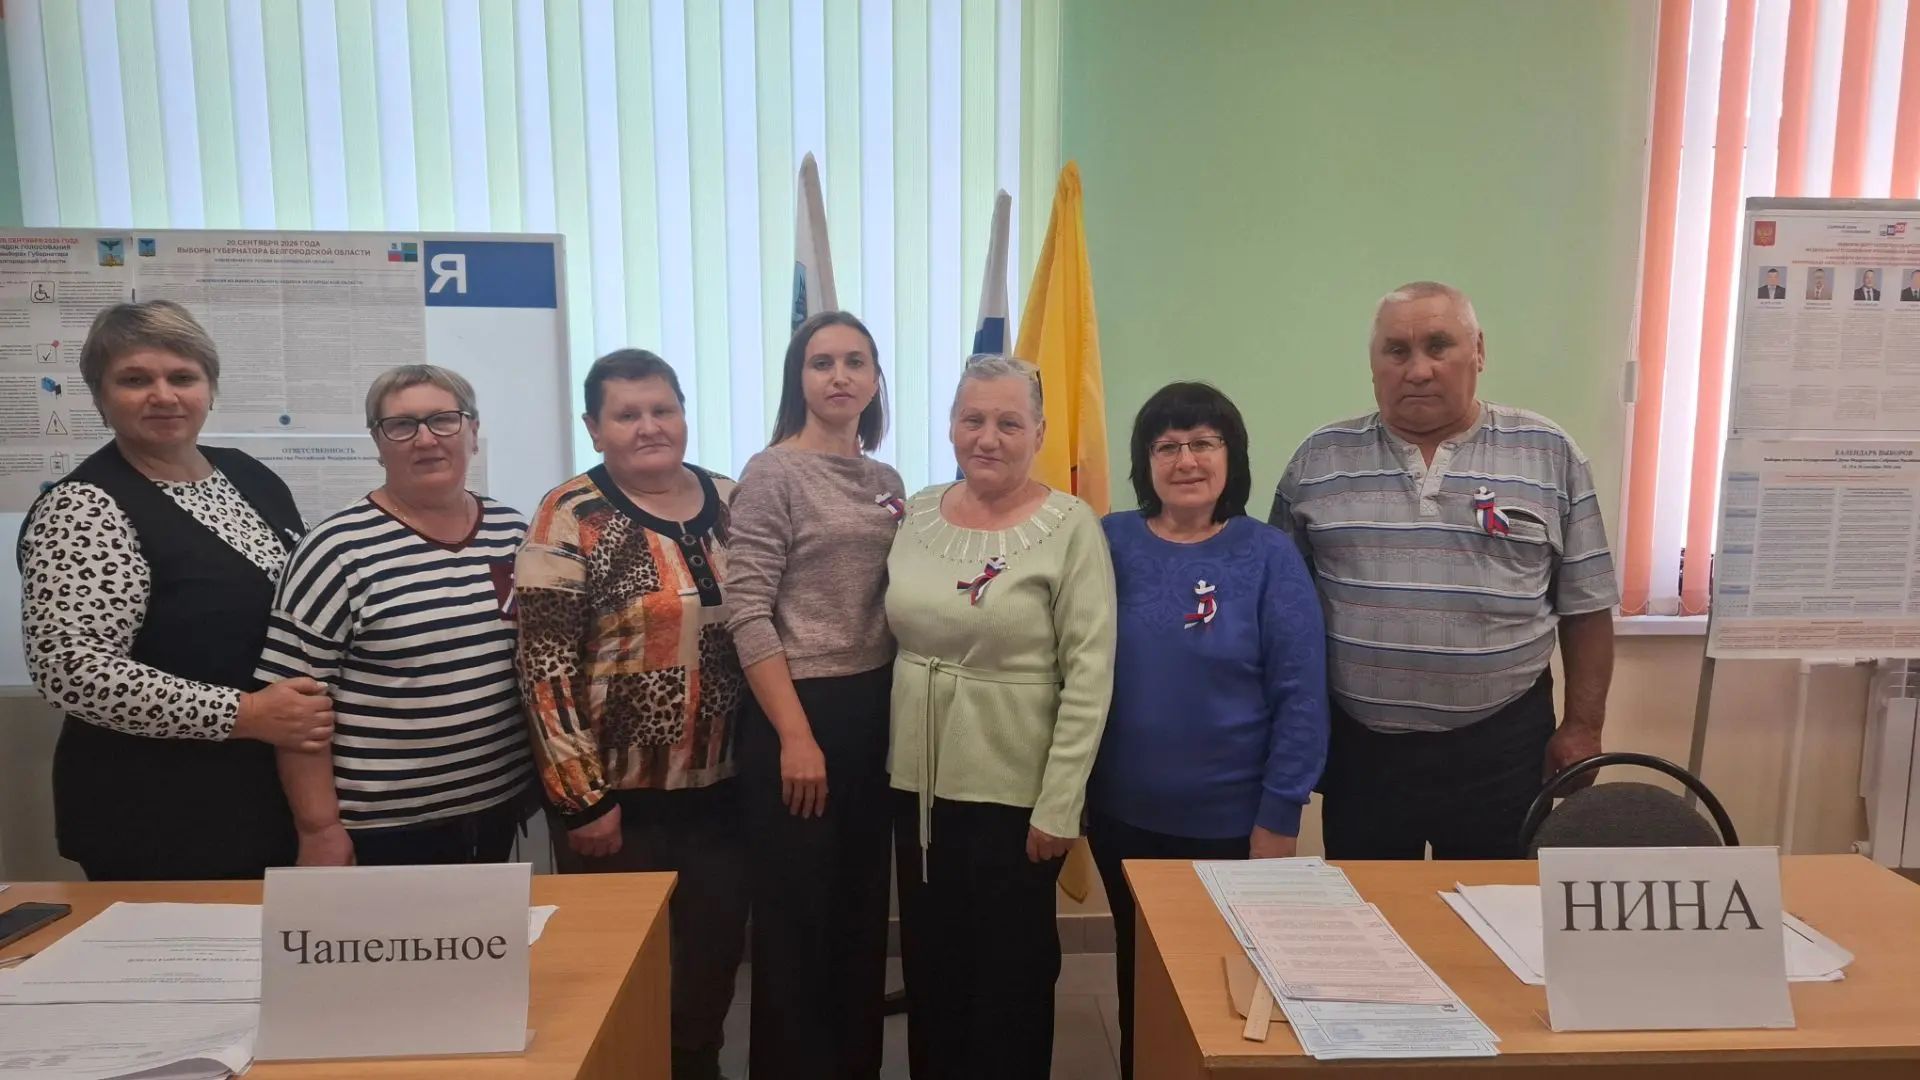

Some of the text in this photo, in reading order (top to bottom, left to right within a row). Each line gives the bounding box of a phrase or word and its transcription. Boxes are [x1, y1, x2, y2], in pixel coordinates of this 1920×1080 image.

[176, 246, 371, 256] ВЫБОРЫ ГУБЕРНАТОРА БЕЛГОРОДСКОЙ ОБЛАСТИ
[429, 253, 467, 294] Я
[1558, 879, 1764, 932] НИНА
[279, 929, 508, 965] Чапельное
